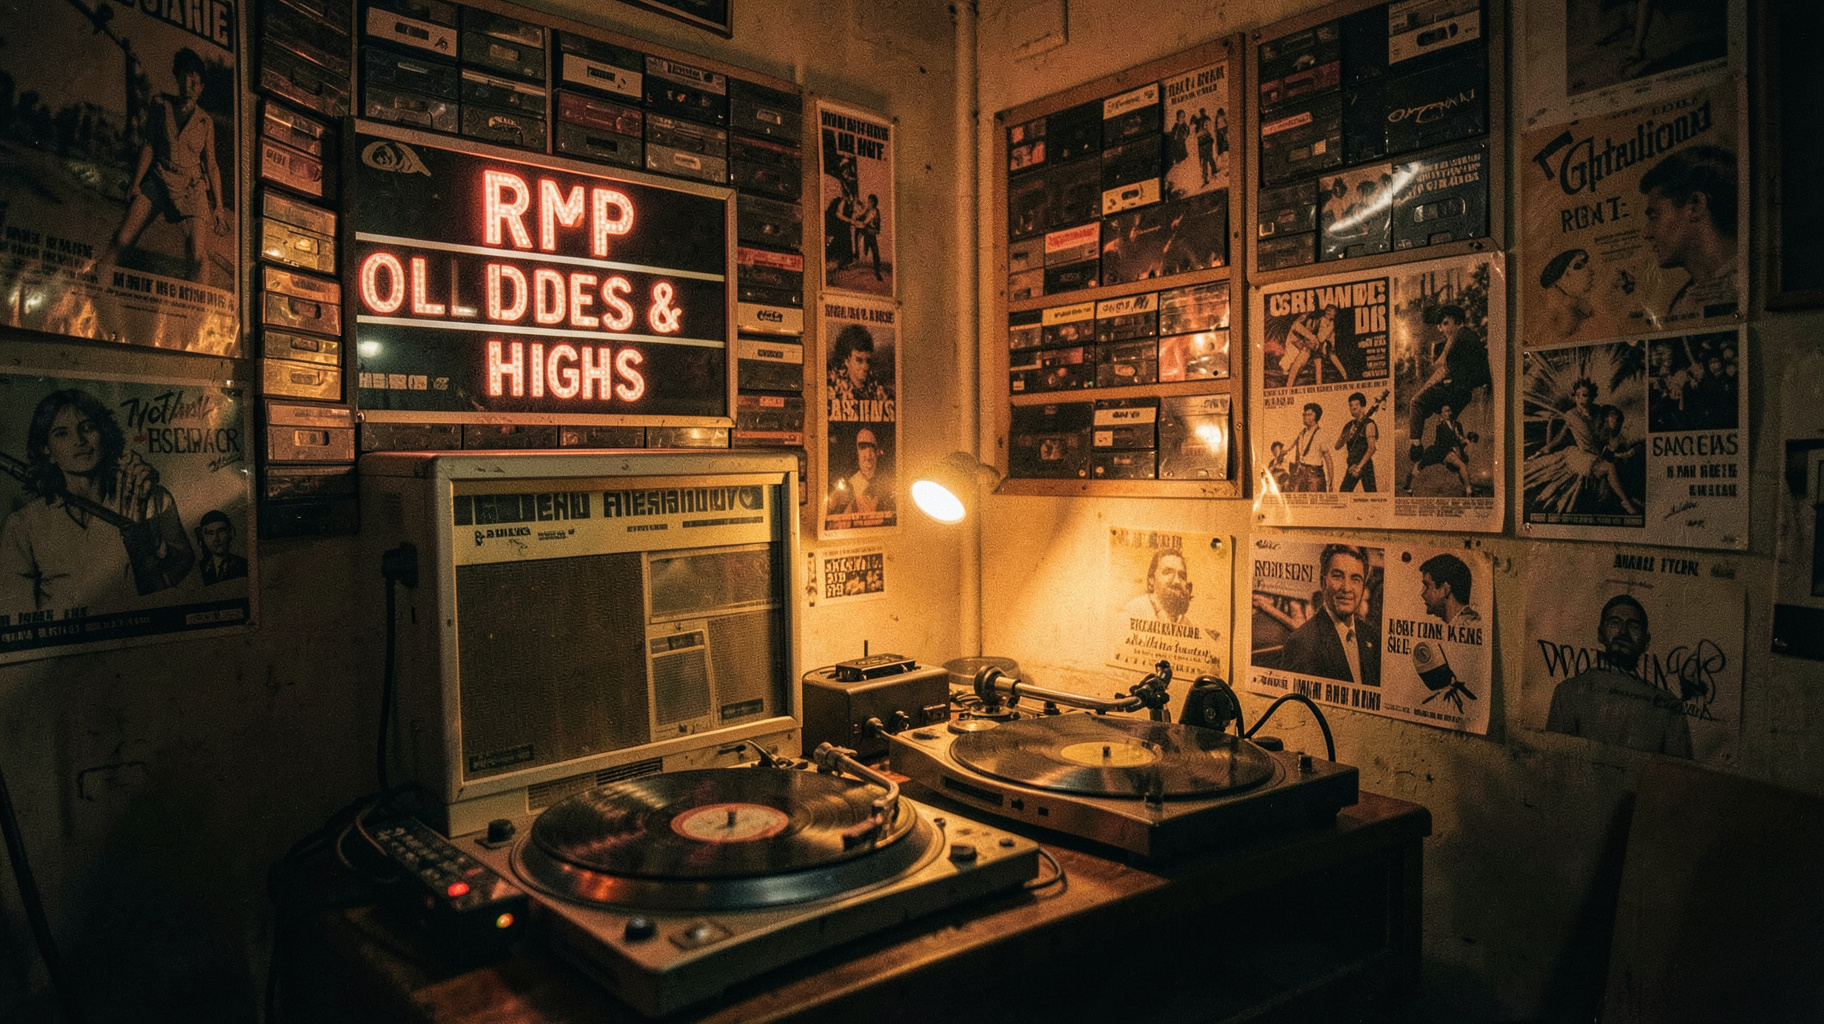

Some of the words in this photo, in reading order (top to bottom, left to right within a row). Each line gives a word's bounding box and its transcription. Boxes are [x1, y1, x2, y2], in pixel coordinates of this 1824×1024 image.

[483, 168, 636, 257] RMP
[649, 281, 683, 334] &
[487, 340, 646, 403] HIGHS
